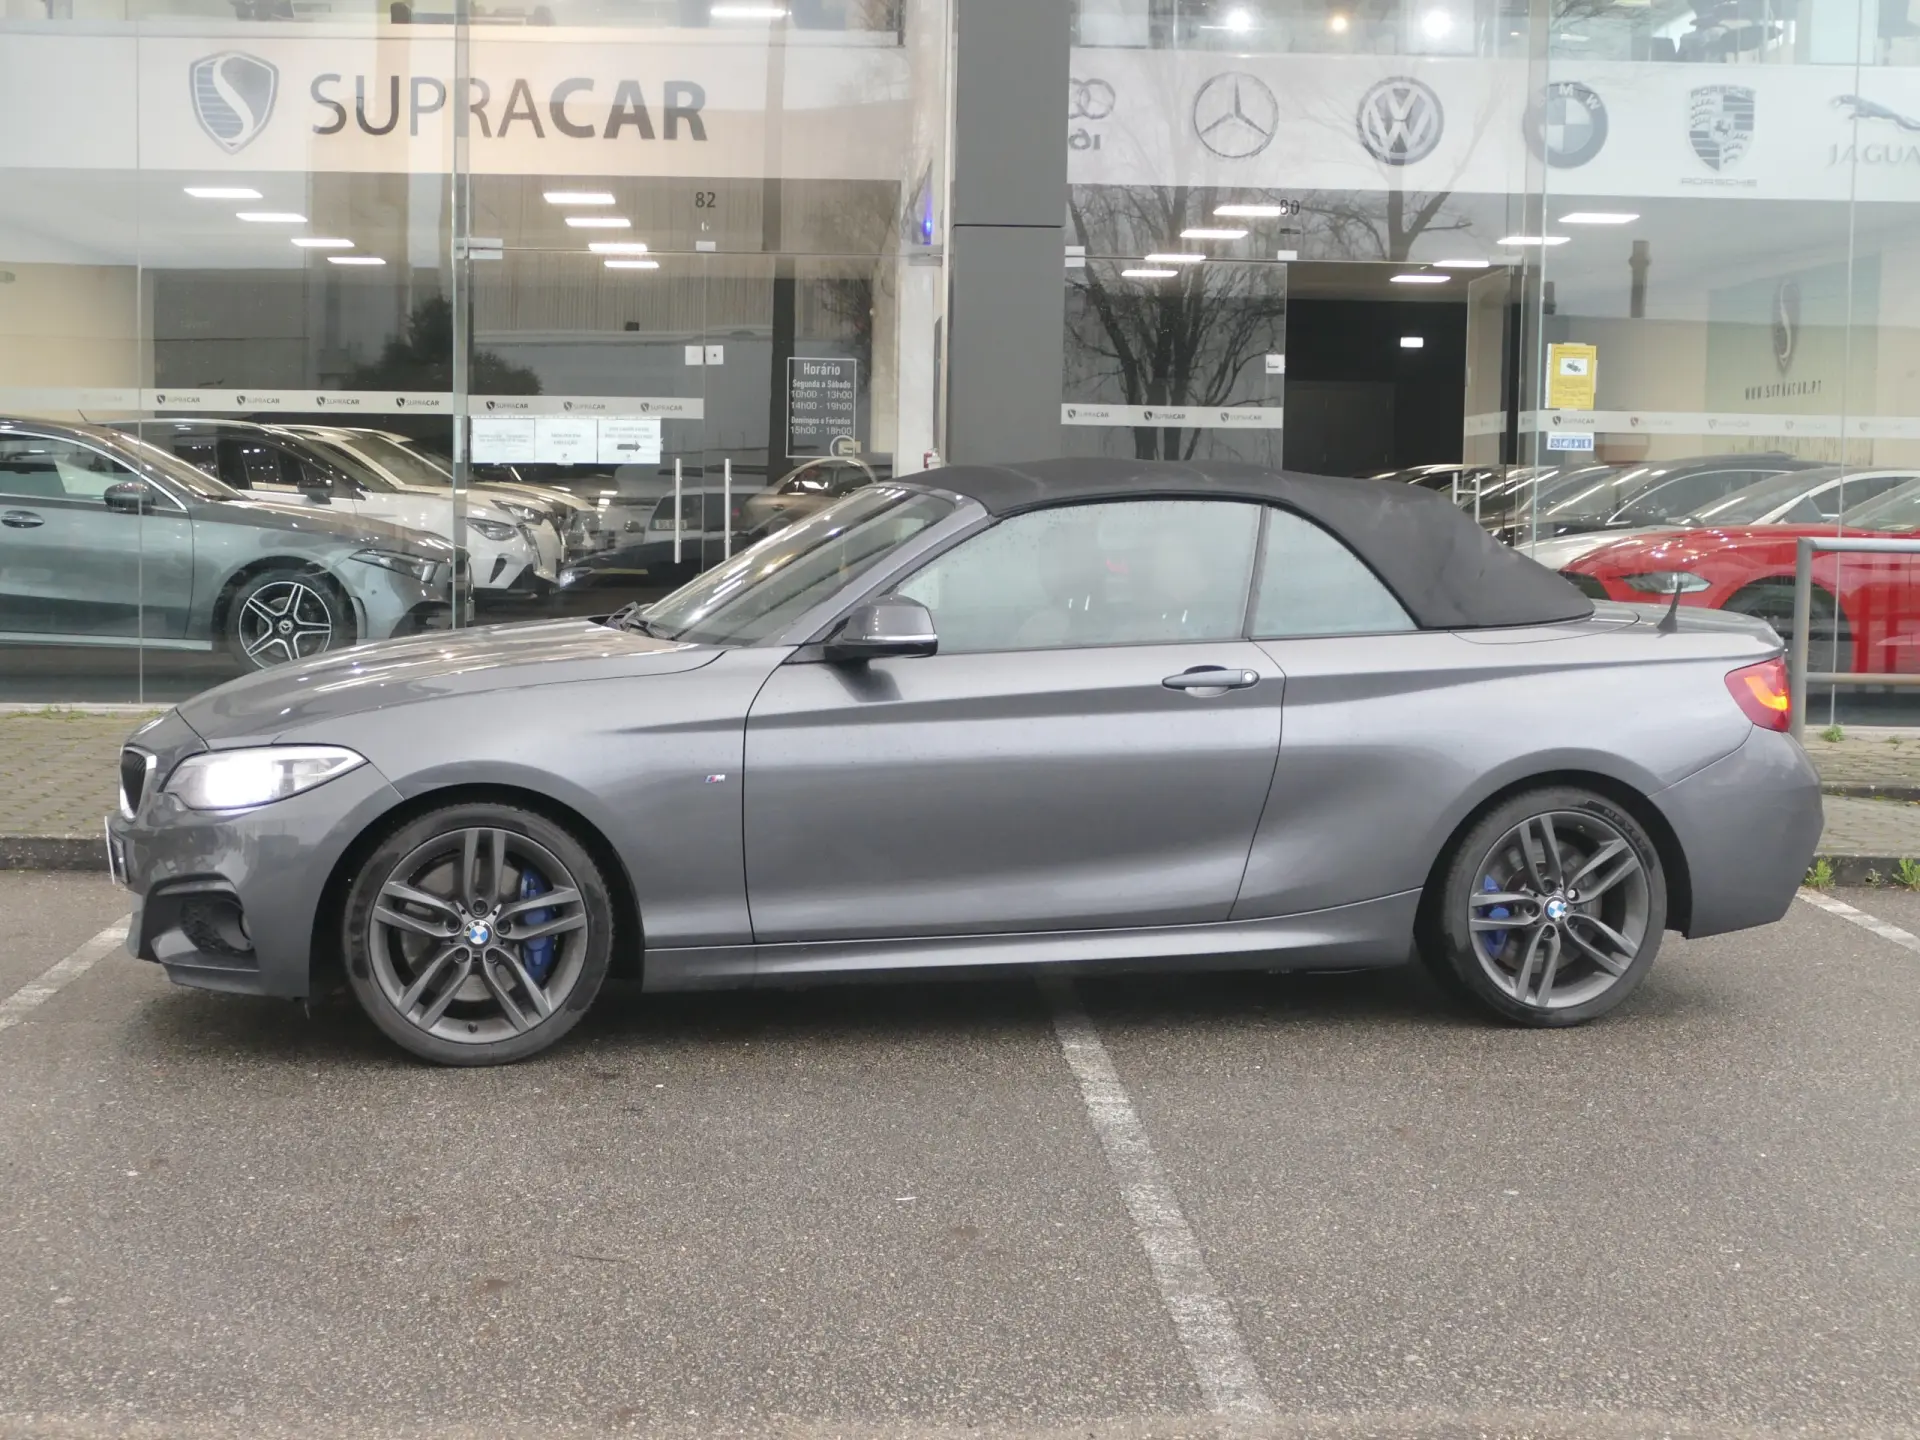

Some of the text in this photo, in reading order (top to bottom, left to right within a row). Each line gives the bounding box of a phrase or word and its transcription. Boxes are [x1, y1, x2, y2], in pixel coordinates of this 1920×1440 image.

[310, 73, 708, 141] SUPRACAR
[1824, 143, 1920, 168] JAGUA
[695, 191, 716, 208] 82
[1280, 199, 1300, 216] 80
[803, 362, 841, 376] Horário
[792, 379, 820, 389] Segunda
[827, 379, 851, 388] Sábado
[791, 390, 818, 398] 10h00
[827, 391, 853, 399] 13h00
[791, 402, 817, 410] 14h00
[826, 402, 853, 410] 19h00
[790, 426, 817, 434] 15h00
